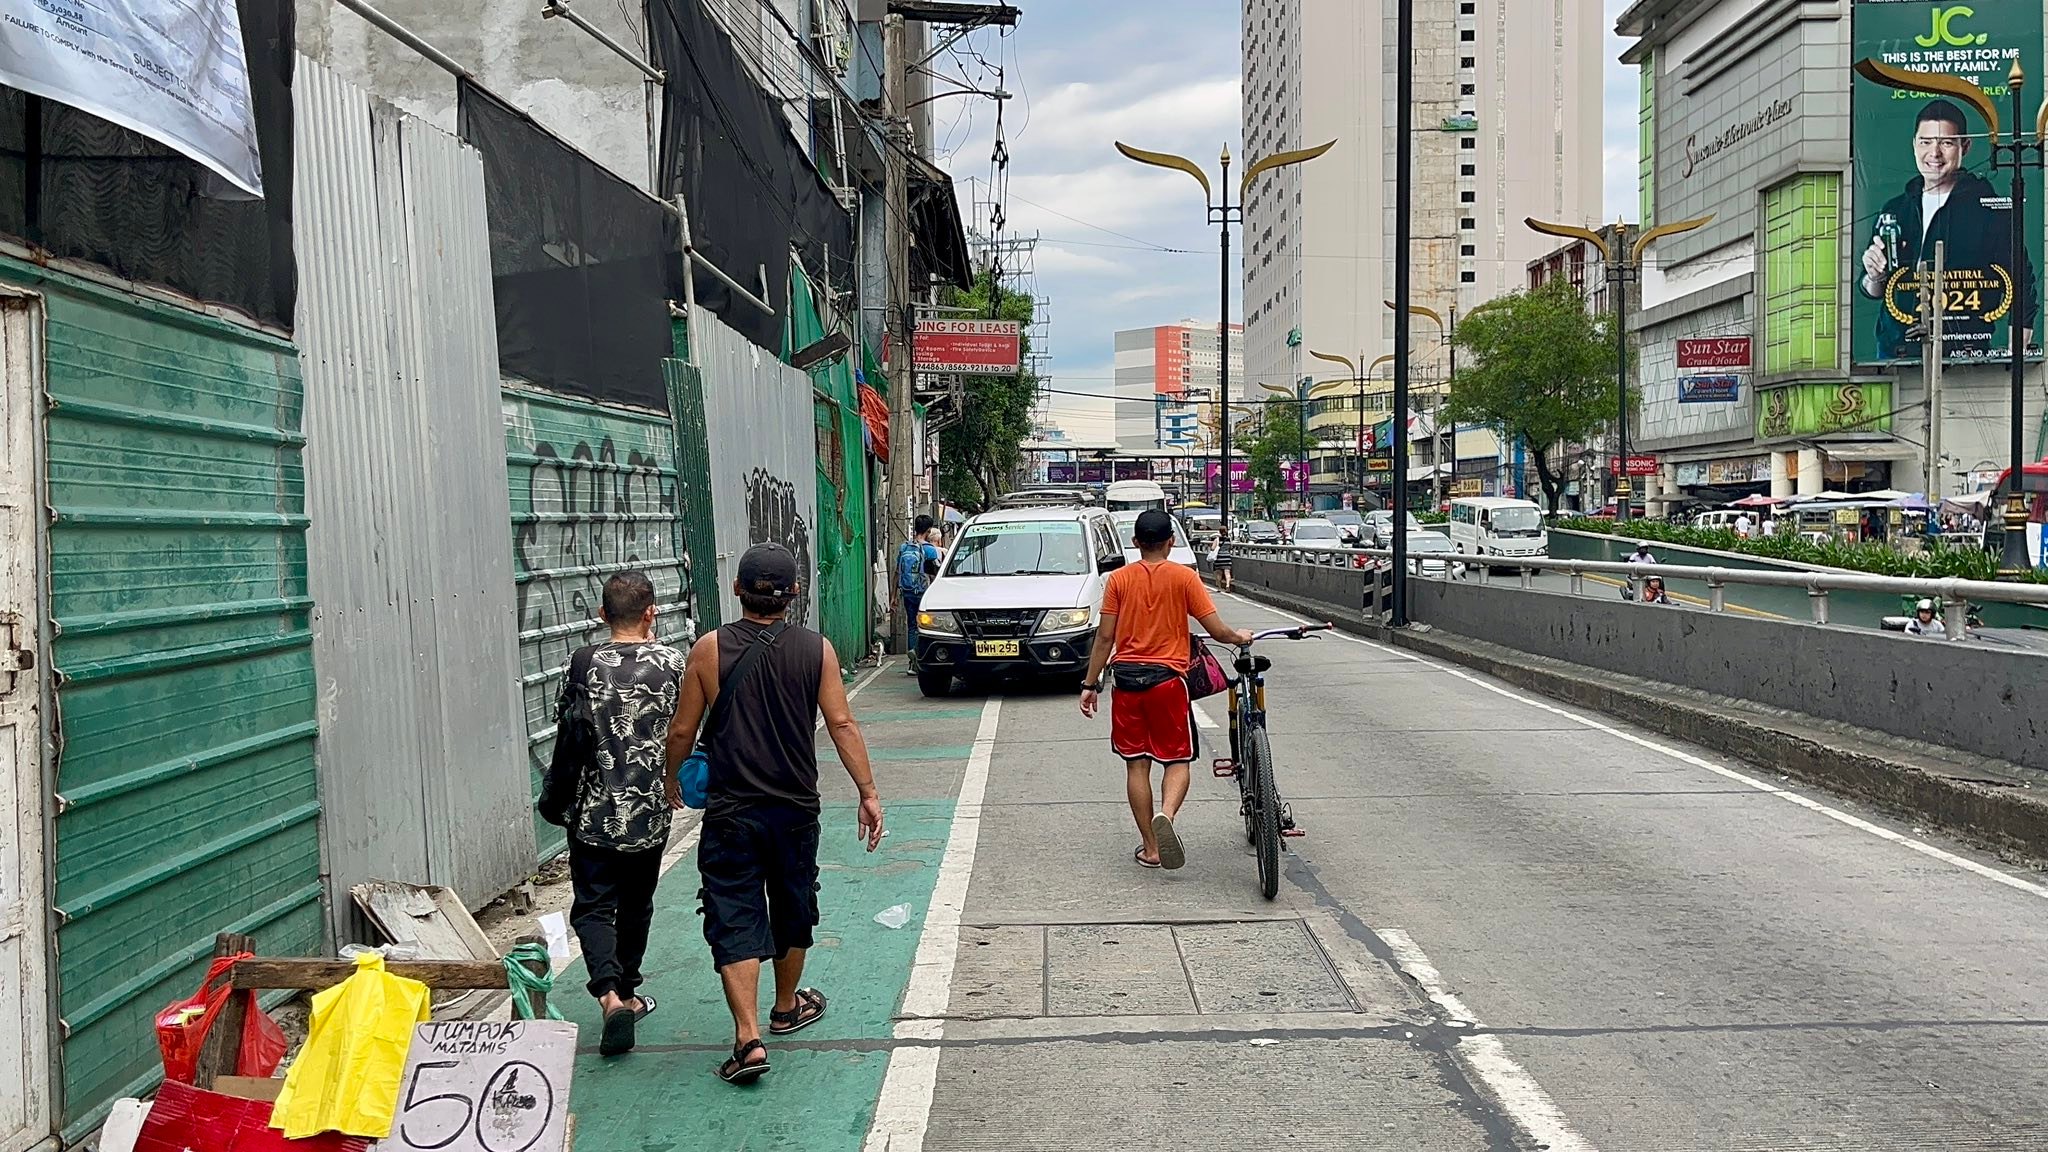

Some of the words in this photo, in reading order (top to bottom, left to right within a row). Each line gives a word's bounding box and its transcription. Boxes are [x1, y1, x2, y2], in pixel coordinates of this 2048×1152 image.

[56, 17, 88, 36] Amount
[4, 13, 40, 34] FAILURE
[40, 27, 51, 39] TO
[50, 33, 80, 52] COMPLY
[80, 48, 96, 60] with
[96, 53, 108, 64] the
[109, 58, 128, 73] Terms
[1882, 53, 1907, 64] THIS
[1909, 52, 1921, 63] IS
[1923, 51, 1944, 62] THE
[1946, 49, 1972, 61] BEST
[1975, 49, 1999, 60] FOR
[133, 52, 174, 83] SUBJECT
[174, 75, 187, 90] TO
[1932, 63, 1951, 73] MY
[1954, 61, 2001, 73] FAMILY.
[1950, 280, 1962, 290] OF
[1963, 279, 1977, 290] THE
[1979, 279, 2000, 290] YEAR
[951, 322, 976, 333] FOR
[980, 323, 1016, 334] LEASE
[1681, 341, 1711, 356] Sun
[1714, 340, 1747, 355] Star
[1687, 356, 1713, 366] Grand
[1714, 355, 1741, 365] Hotel
[998, 643, 1018, 653] 293
[427, 1022, 521, 1044] TUMPOK
[433, 1041, 507, 1054] MATAMIS
[401, 1060, 553, 1152] 50
